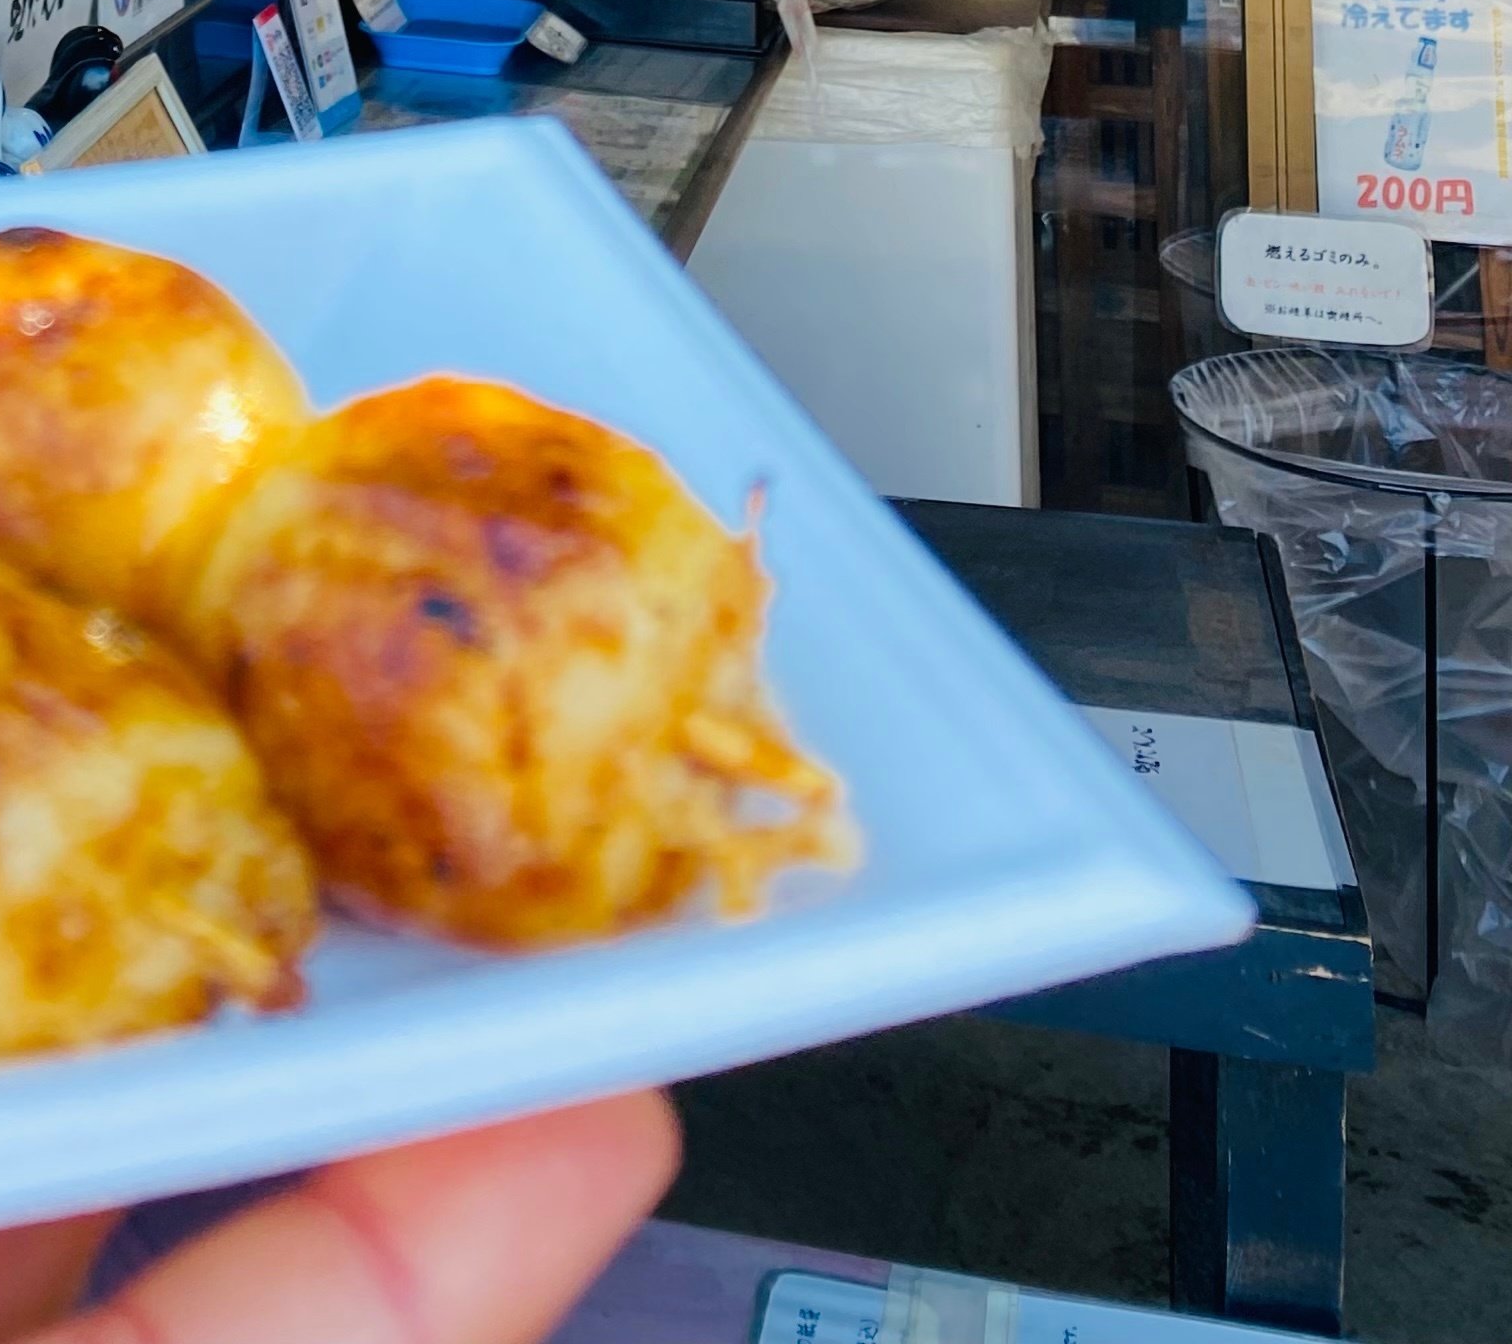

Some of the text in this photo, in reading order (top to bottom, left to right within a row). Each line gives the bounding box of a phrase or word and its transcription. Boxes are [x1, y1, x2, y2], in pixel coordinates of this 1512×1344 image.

[1341, 2, 1474, 31] 冷えてます
[1356, 174, 1475, 215] 200円
